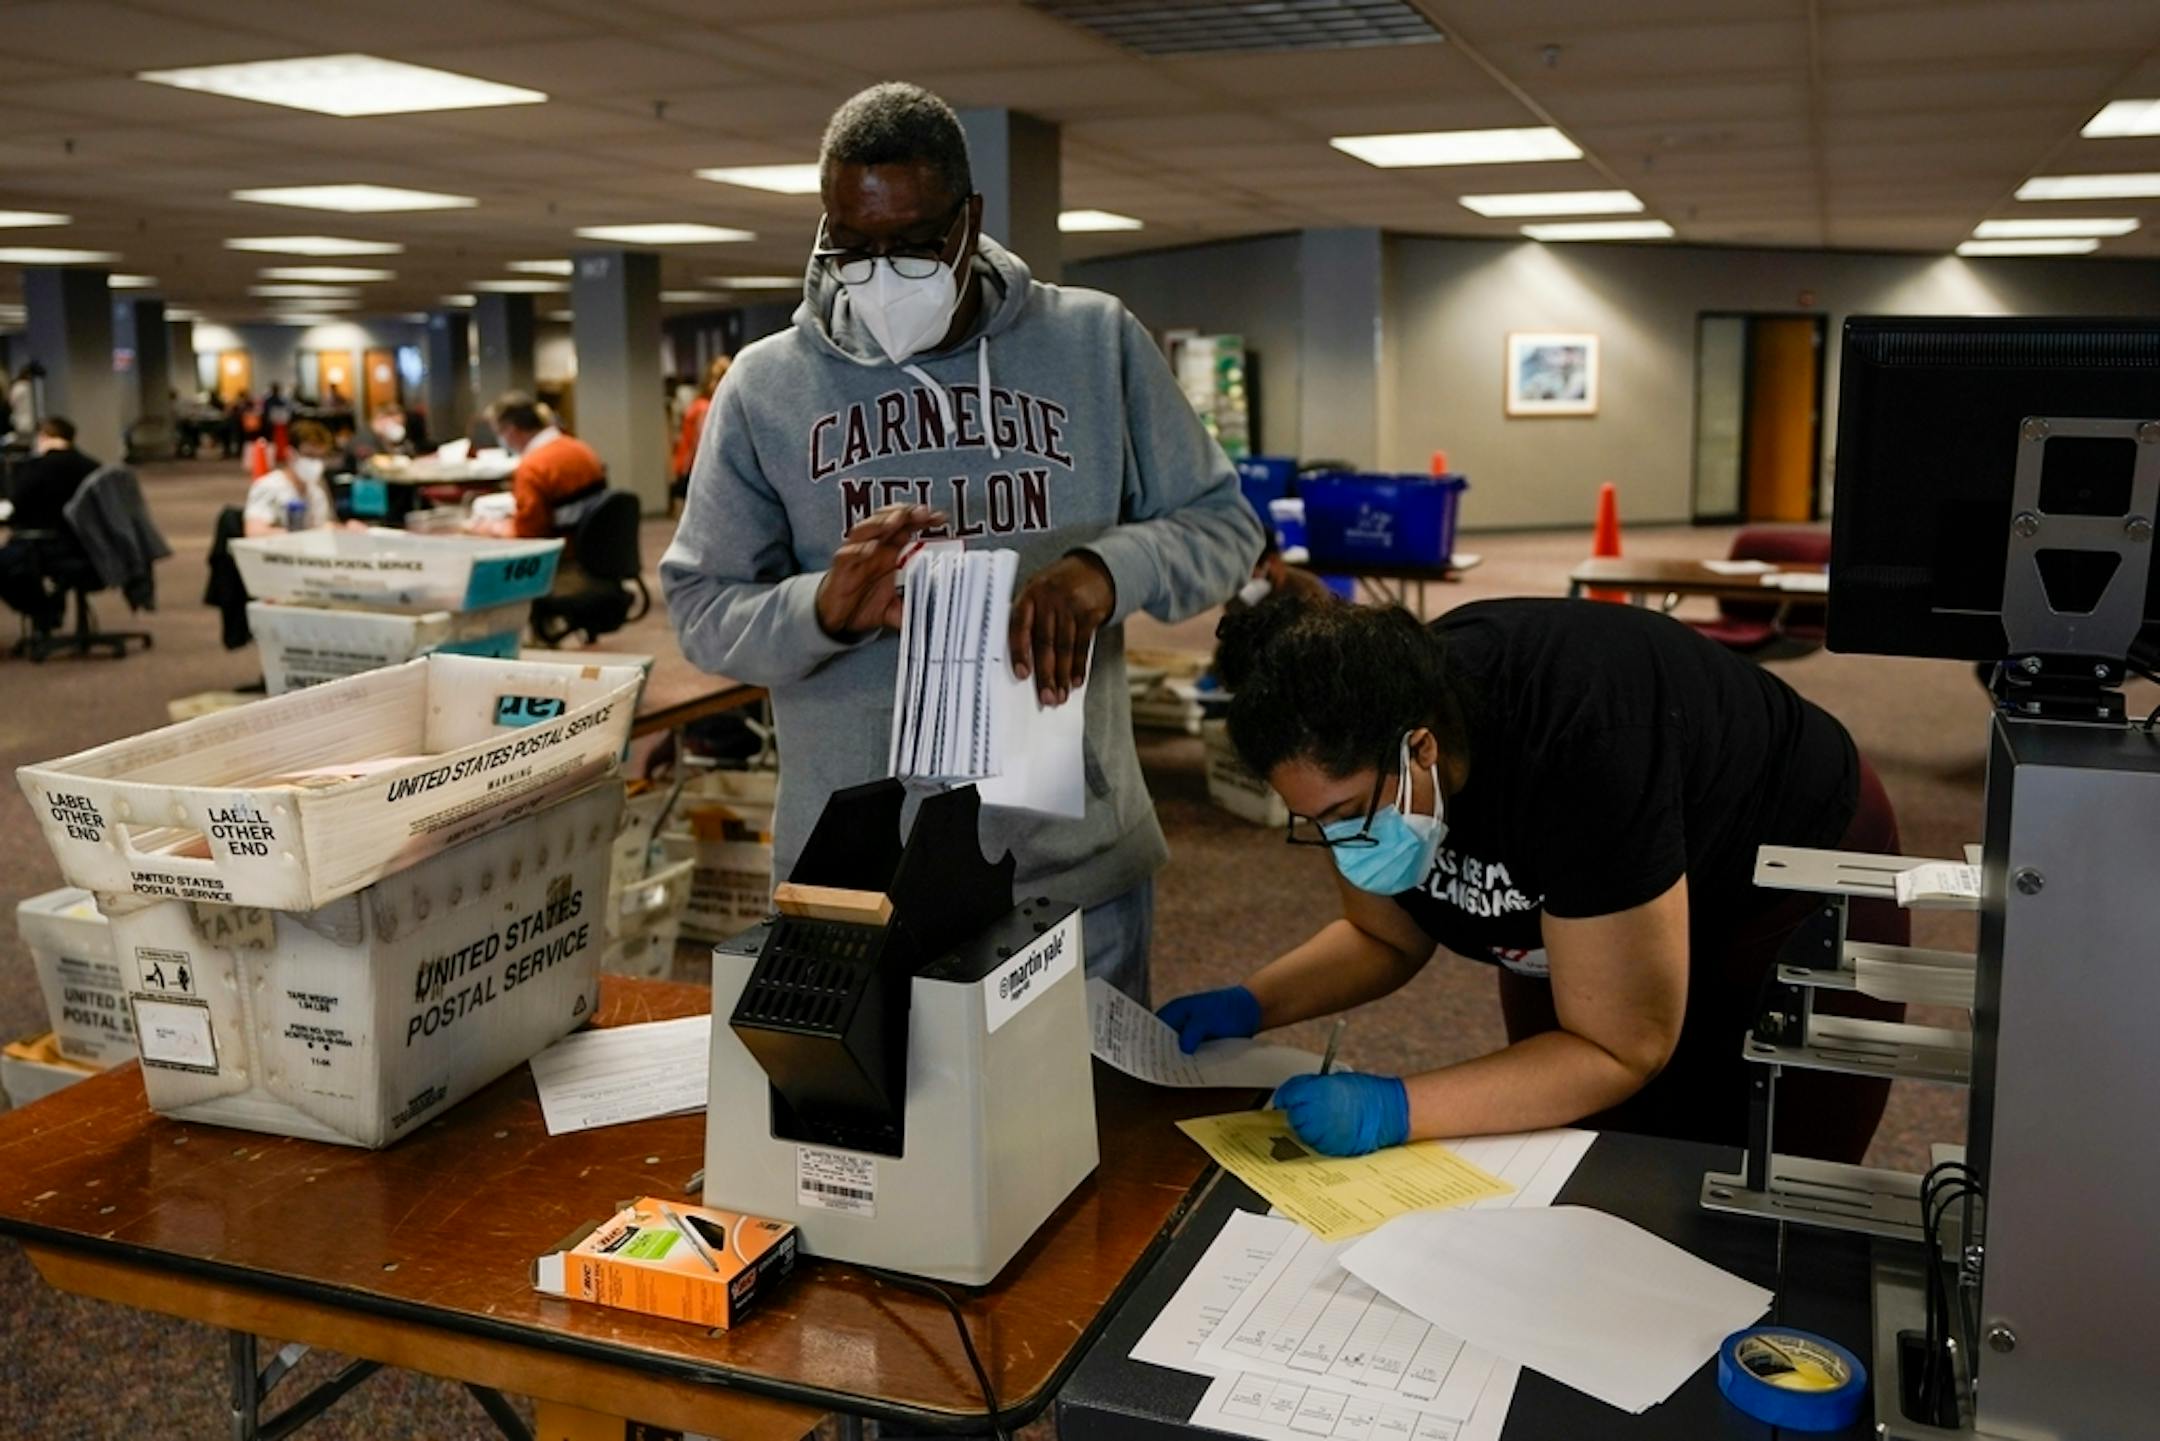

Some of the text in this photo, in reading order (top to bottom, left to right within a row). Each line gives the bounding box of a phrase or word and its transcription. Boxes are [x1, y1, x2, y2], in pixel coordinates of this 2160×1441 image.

[809, 383, 1075, 483] CARNEGIE
[503, 557, 540, 582] 160
[387, 766, 452, 802] UNITED
[451, 746, 514, 781] STATES
[511, 726, 565, 760] POSTAL
[564, 703, 615, 740] SERVICE
[486, 765, 533, 791] WARNING
[47, 791, 98, 813] LABEL
[51, 808, 106, 829] OTHER
[208, 808, 269, 824] LAL
[66, 825, 101, 843] END
[211, 824, 276, 841] OTHER
[229, 841, 268, 857] END
[131, 871, 226, 890] UNITED STATES
[132, 883, 234, 903] POSTAL SERVICE
[415, 890, 583, 999] UNITED STATES
[1009, 950, 1042, 992] martin
[406, 923, 590, 1047] POSTAL SERVICE
[64, 987, 116, 1010] UNITED
[62, 1005, 119, 1031] POSTAL
